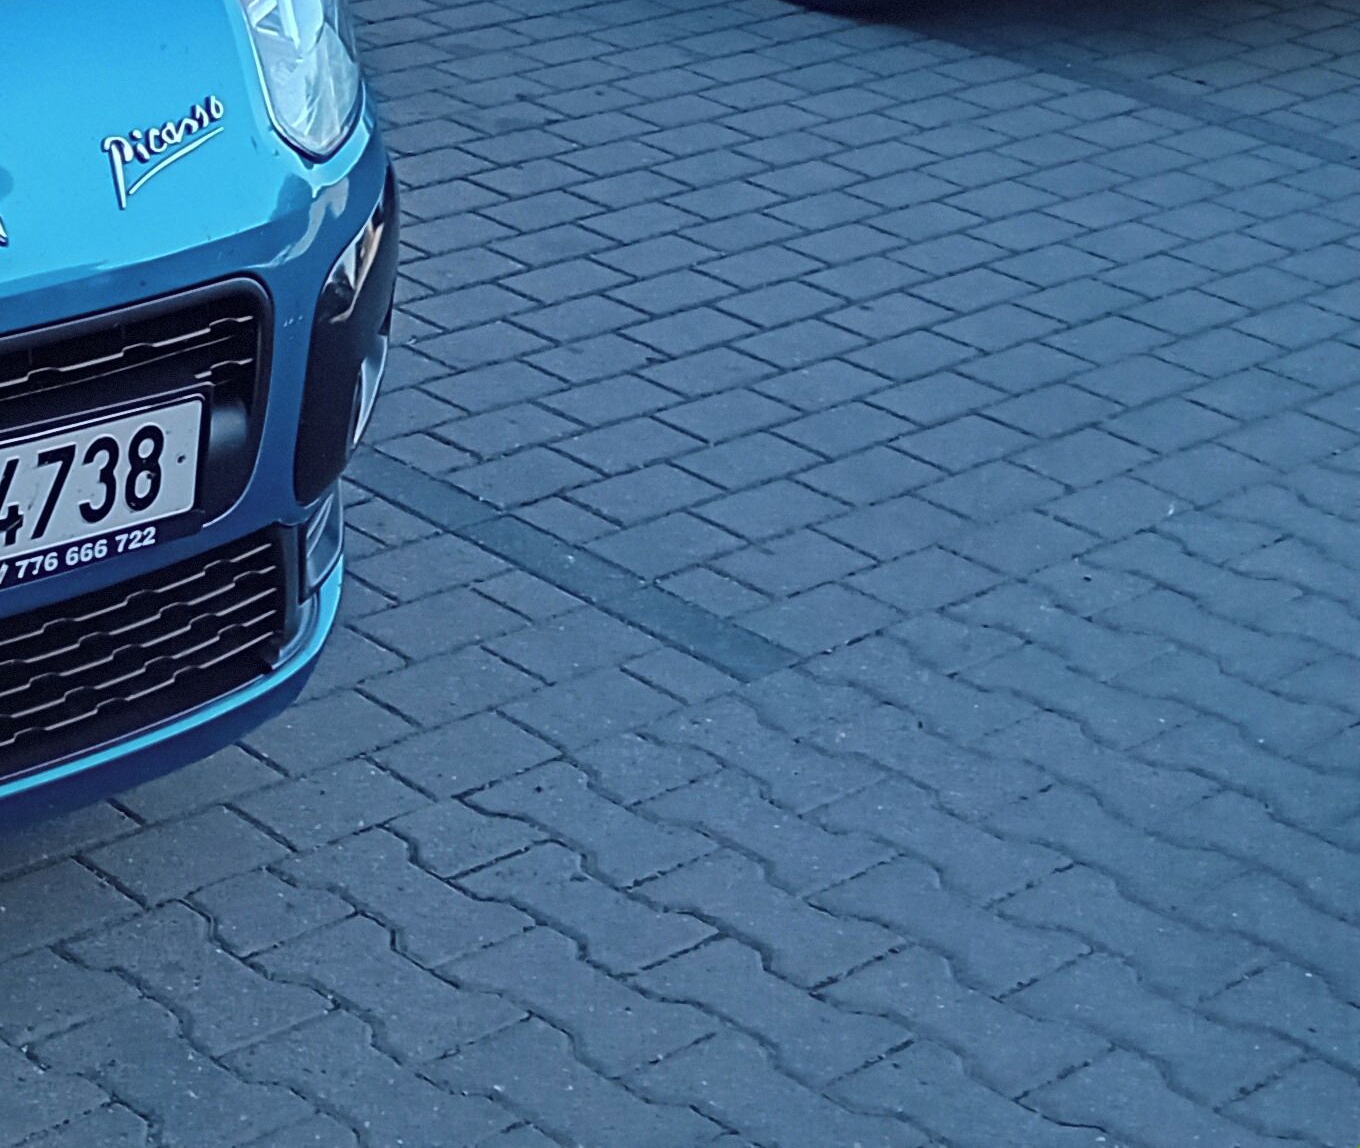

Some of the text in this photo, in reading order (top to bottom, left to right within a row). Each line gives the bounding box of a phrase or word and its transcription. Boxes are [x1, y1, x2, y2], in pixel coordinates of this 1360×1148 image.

[102, 95, 225, 210] Picasso
[15, 551, 59, 579] 776
[65, 539, 109, 566] 666
[115, 526, 157, 553] 722
